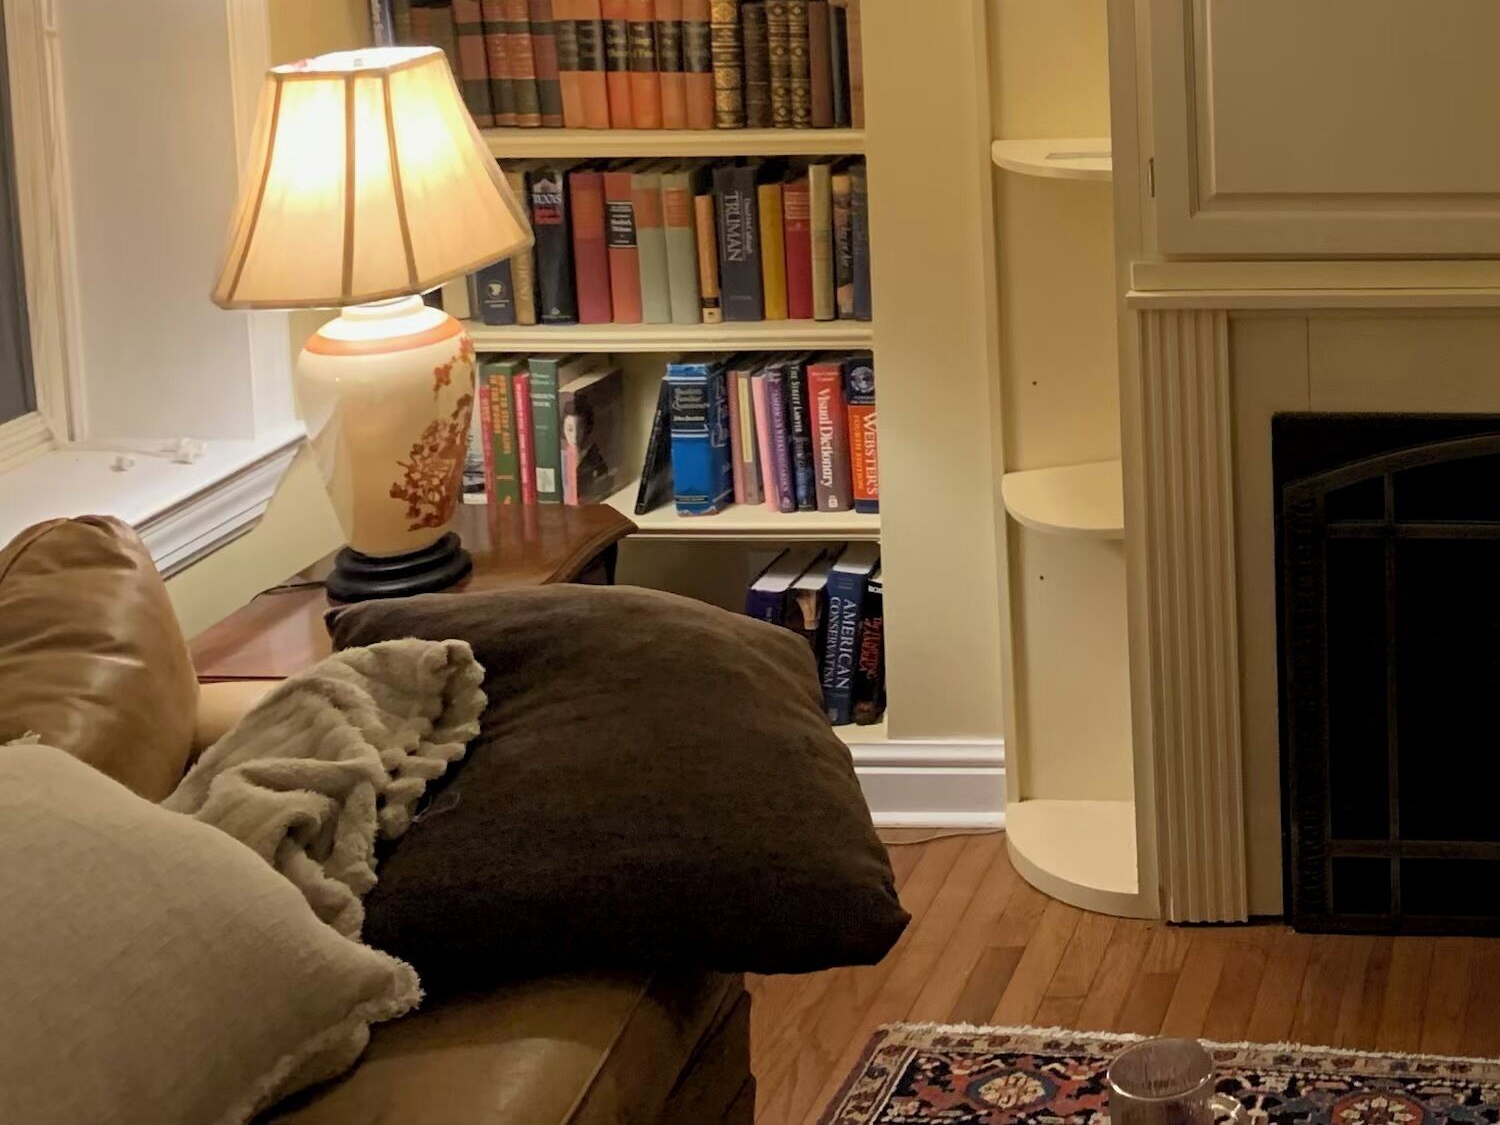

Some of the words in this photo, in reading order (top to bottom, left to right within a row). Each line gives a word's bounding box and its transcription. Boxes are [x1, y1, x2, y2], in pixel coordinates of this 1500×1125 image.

[724, 190, 742, 262] TRUMAN
[790, 366, 799, 379] THE
[792, 381, 802, 405] STREET
[817, 388, 832, 424] Visual
[793, 406, 803, 433] LAWYER
[853, 414, 863, 450] FOURTH
[819, 427, 834, 488] Dictionary
[855, 453, 864, 490] EDITION
[863, 412, 878, 495] WEBSTER'S
[823, 597, 841, 688] CONSERVATISM
[836, 599, 856, 690] AMERICAN
